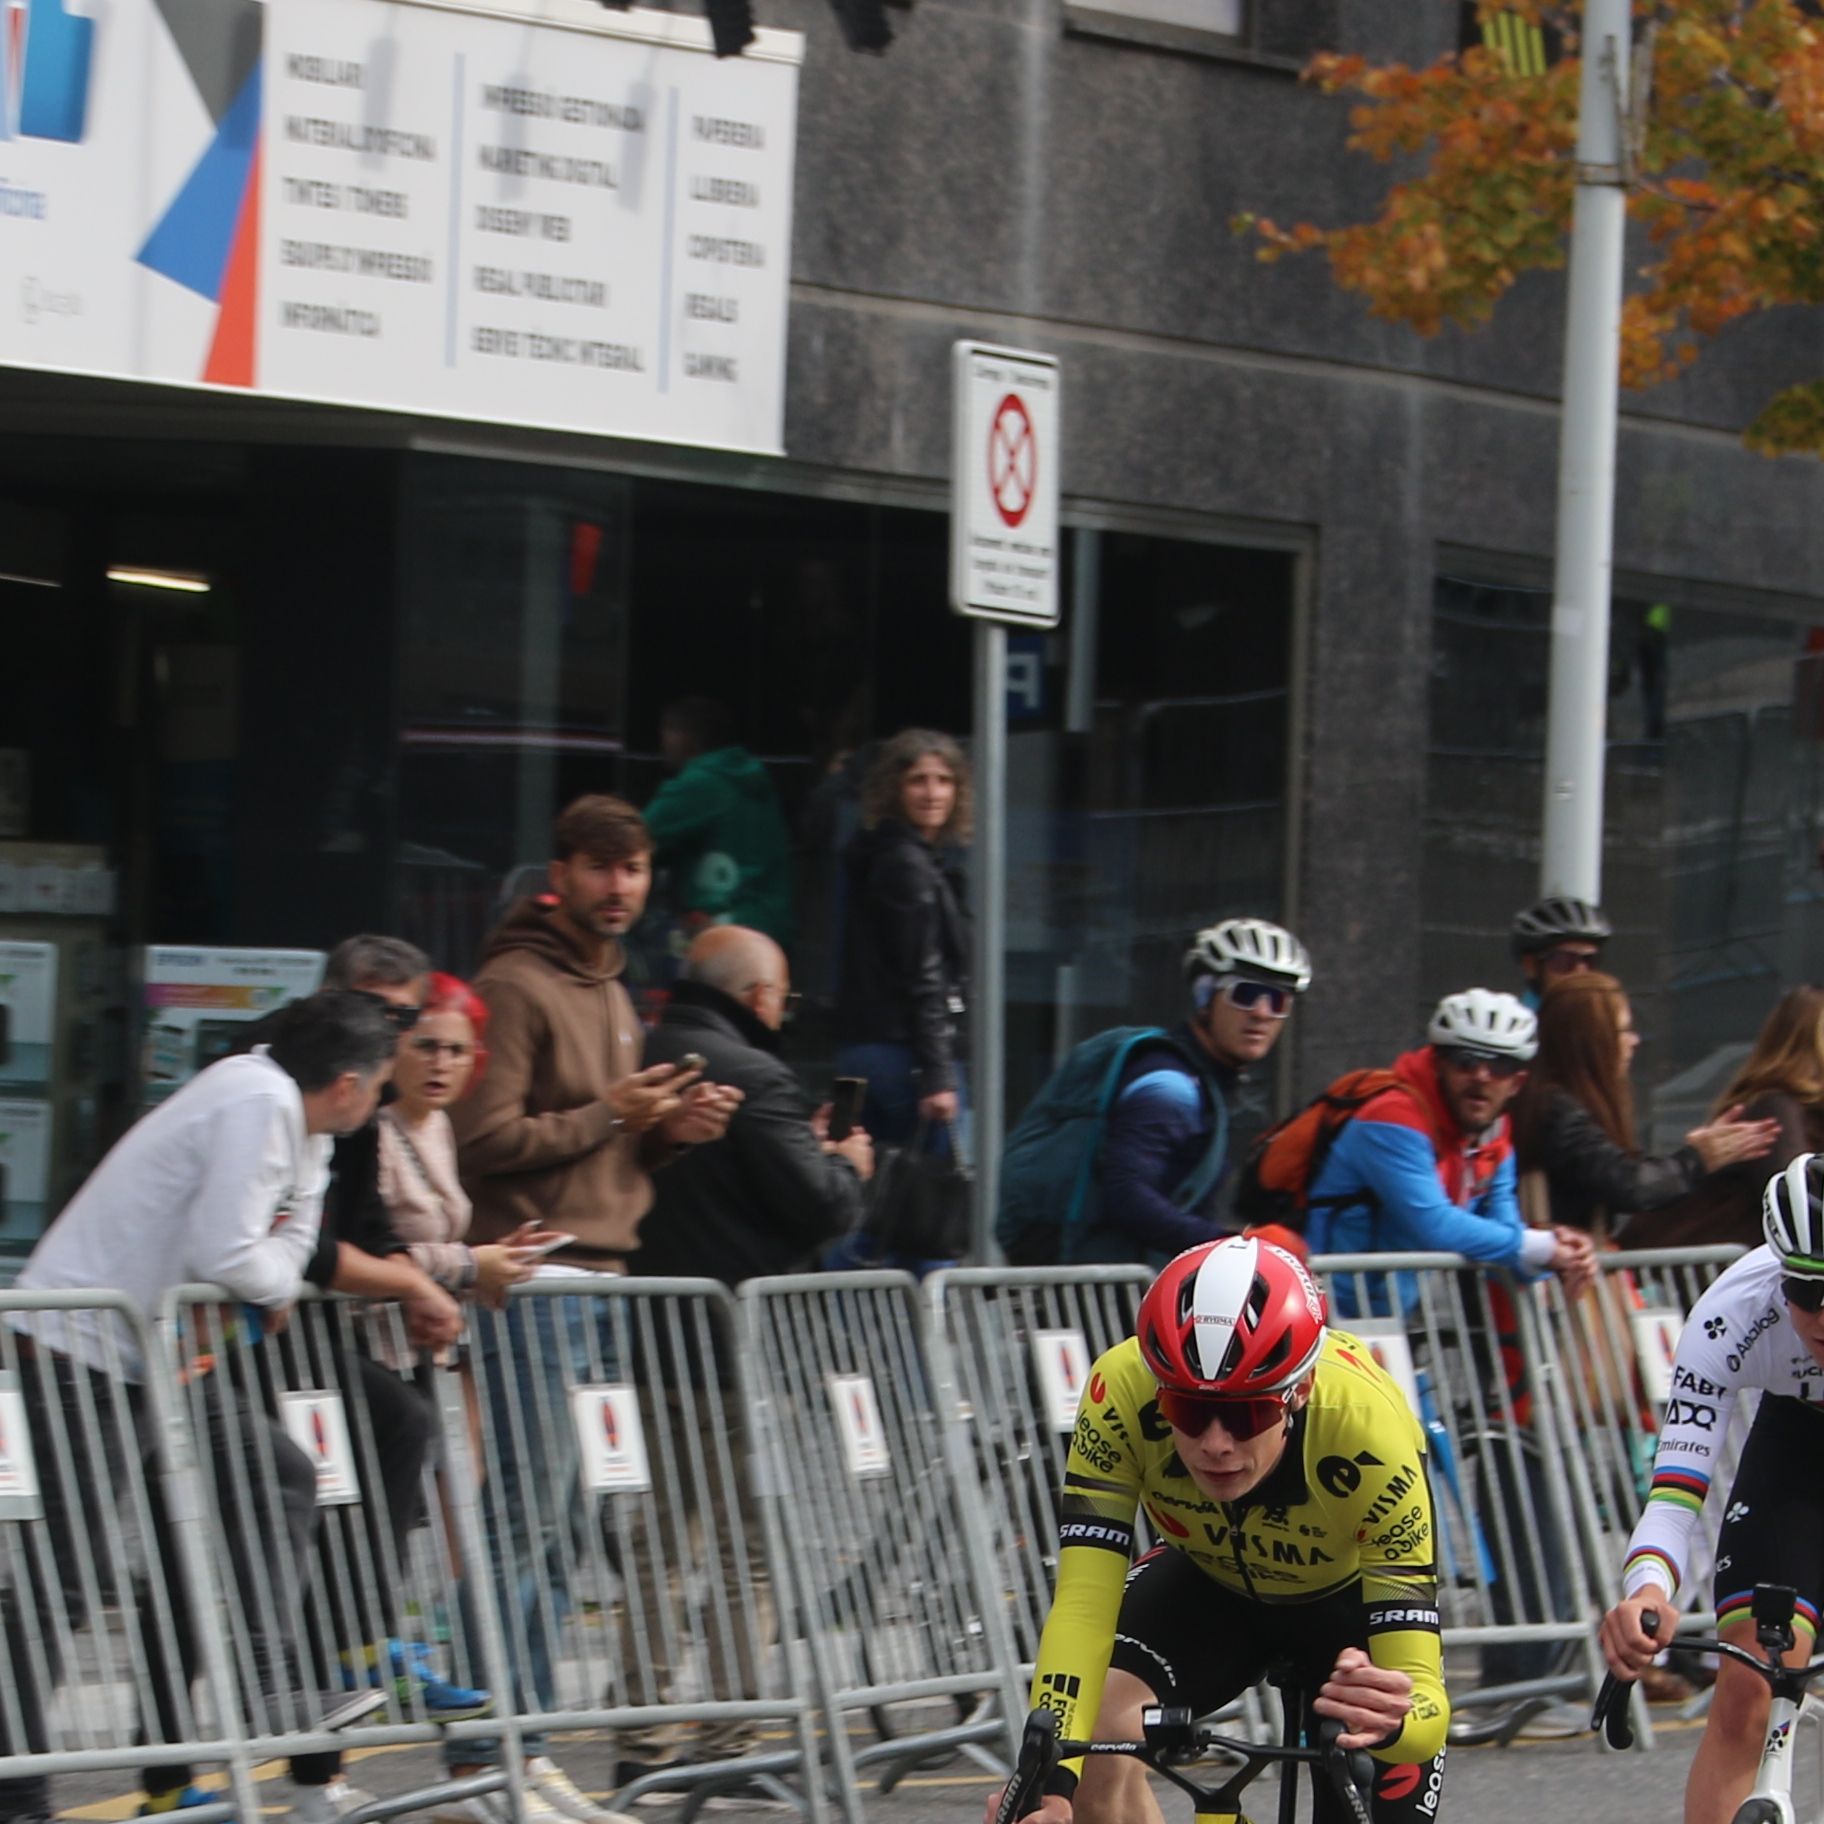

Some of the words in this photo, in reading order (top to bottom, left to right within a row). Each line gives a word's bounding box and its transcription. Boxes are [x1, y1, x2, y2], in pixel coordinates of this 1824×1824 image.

[1736, 1307, 1781, 1360] Analog
[1363, 1464, 1418, 1525] VISMA
[1060, 1523, 1130, 1546] SRAM
[1369, 1609, 1440, 1626] SRAM
